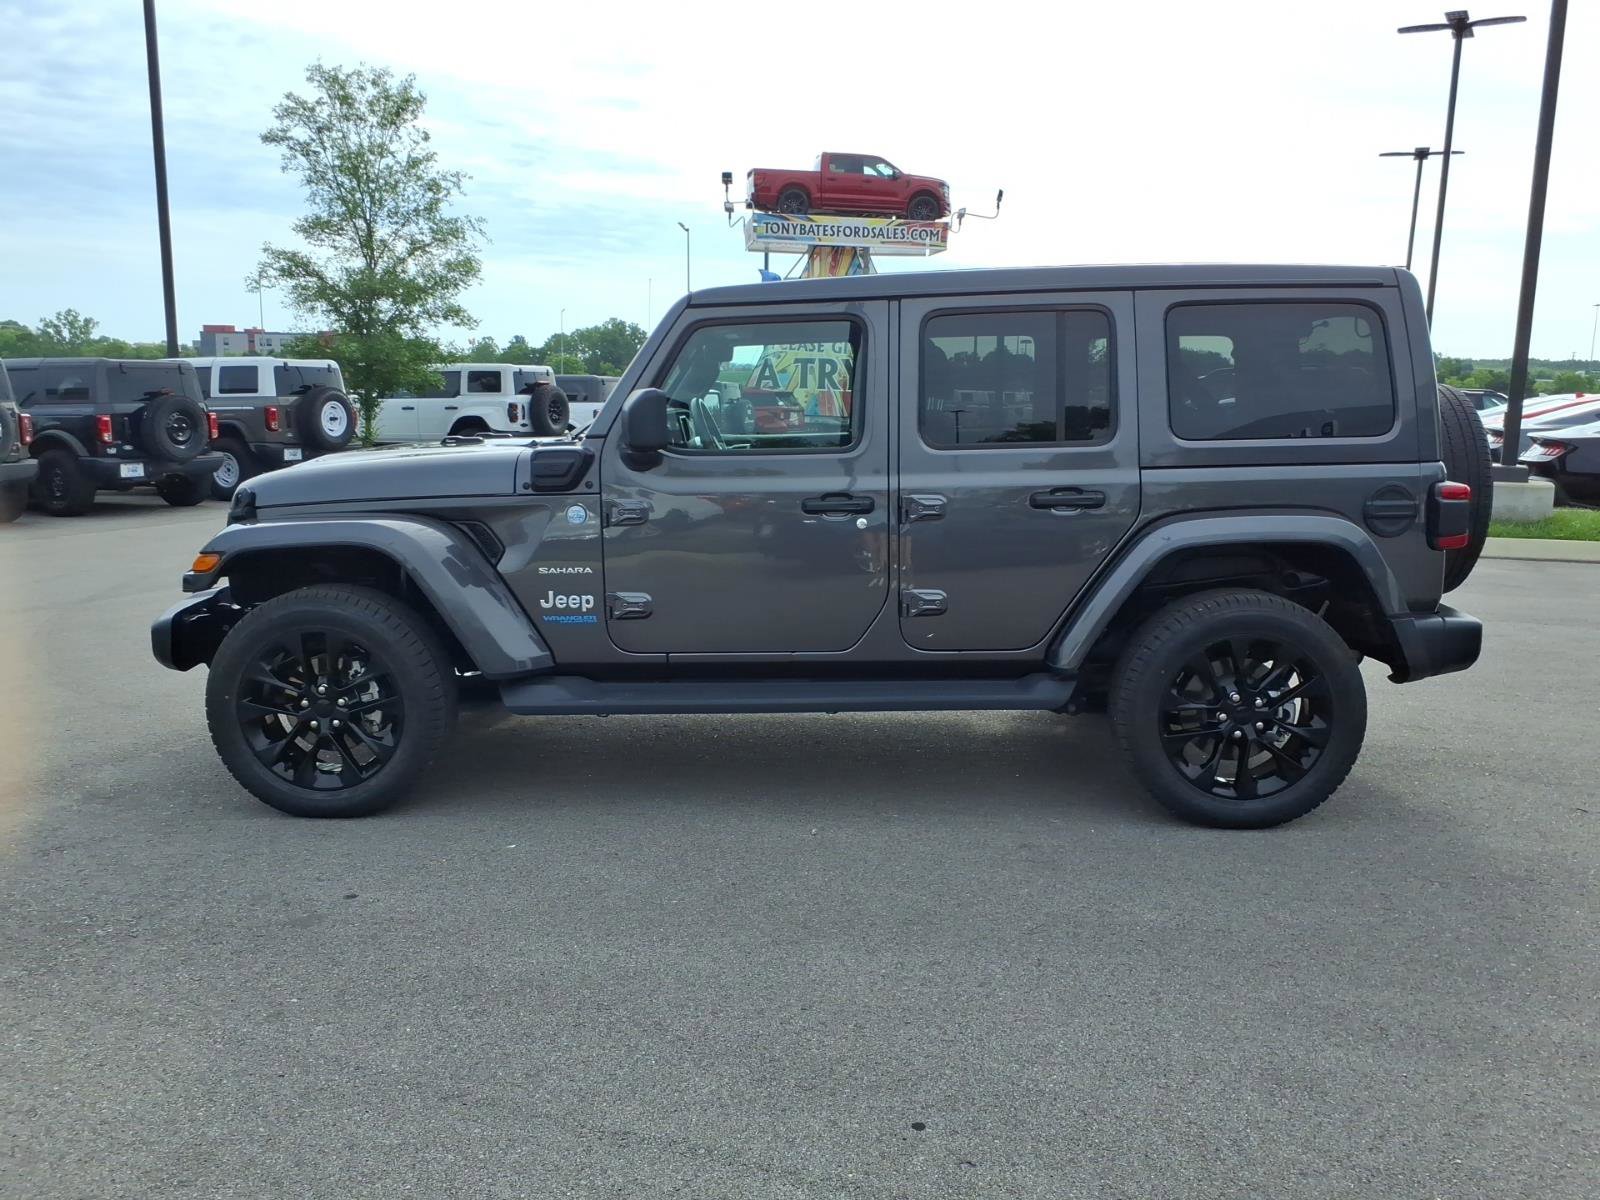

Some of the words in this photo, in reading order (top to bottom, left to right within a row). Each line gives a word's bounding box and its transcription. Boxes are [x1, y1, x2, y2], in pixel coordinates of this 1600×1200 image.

[763, 221, 941, 242] TONYBATESFORDSALES.COM
[755, 357, 781, 390] A
[540, 590, 594, 612] Jeep
